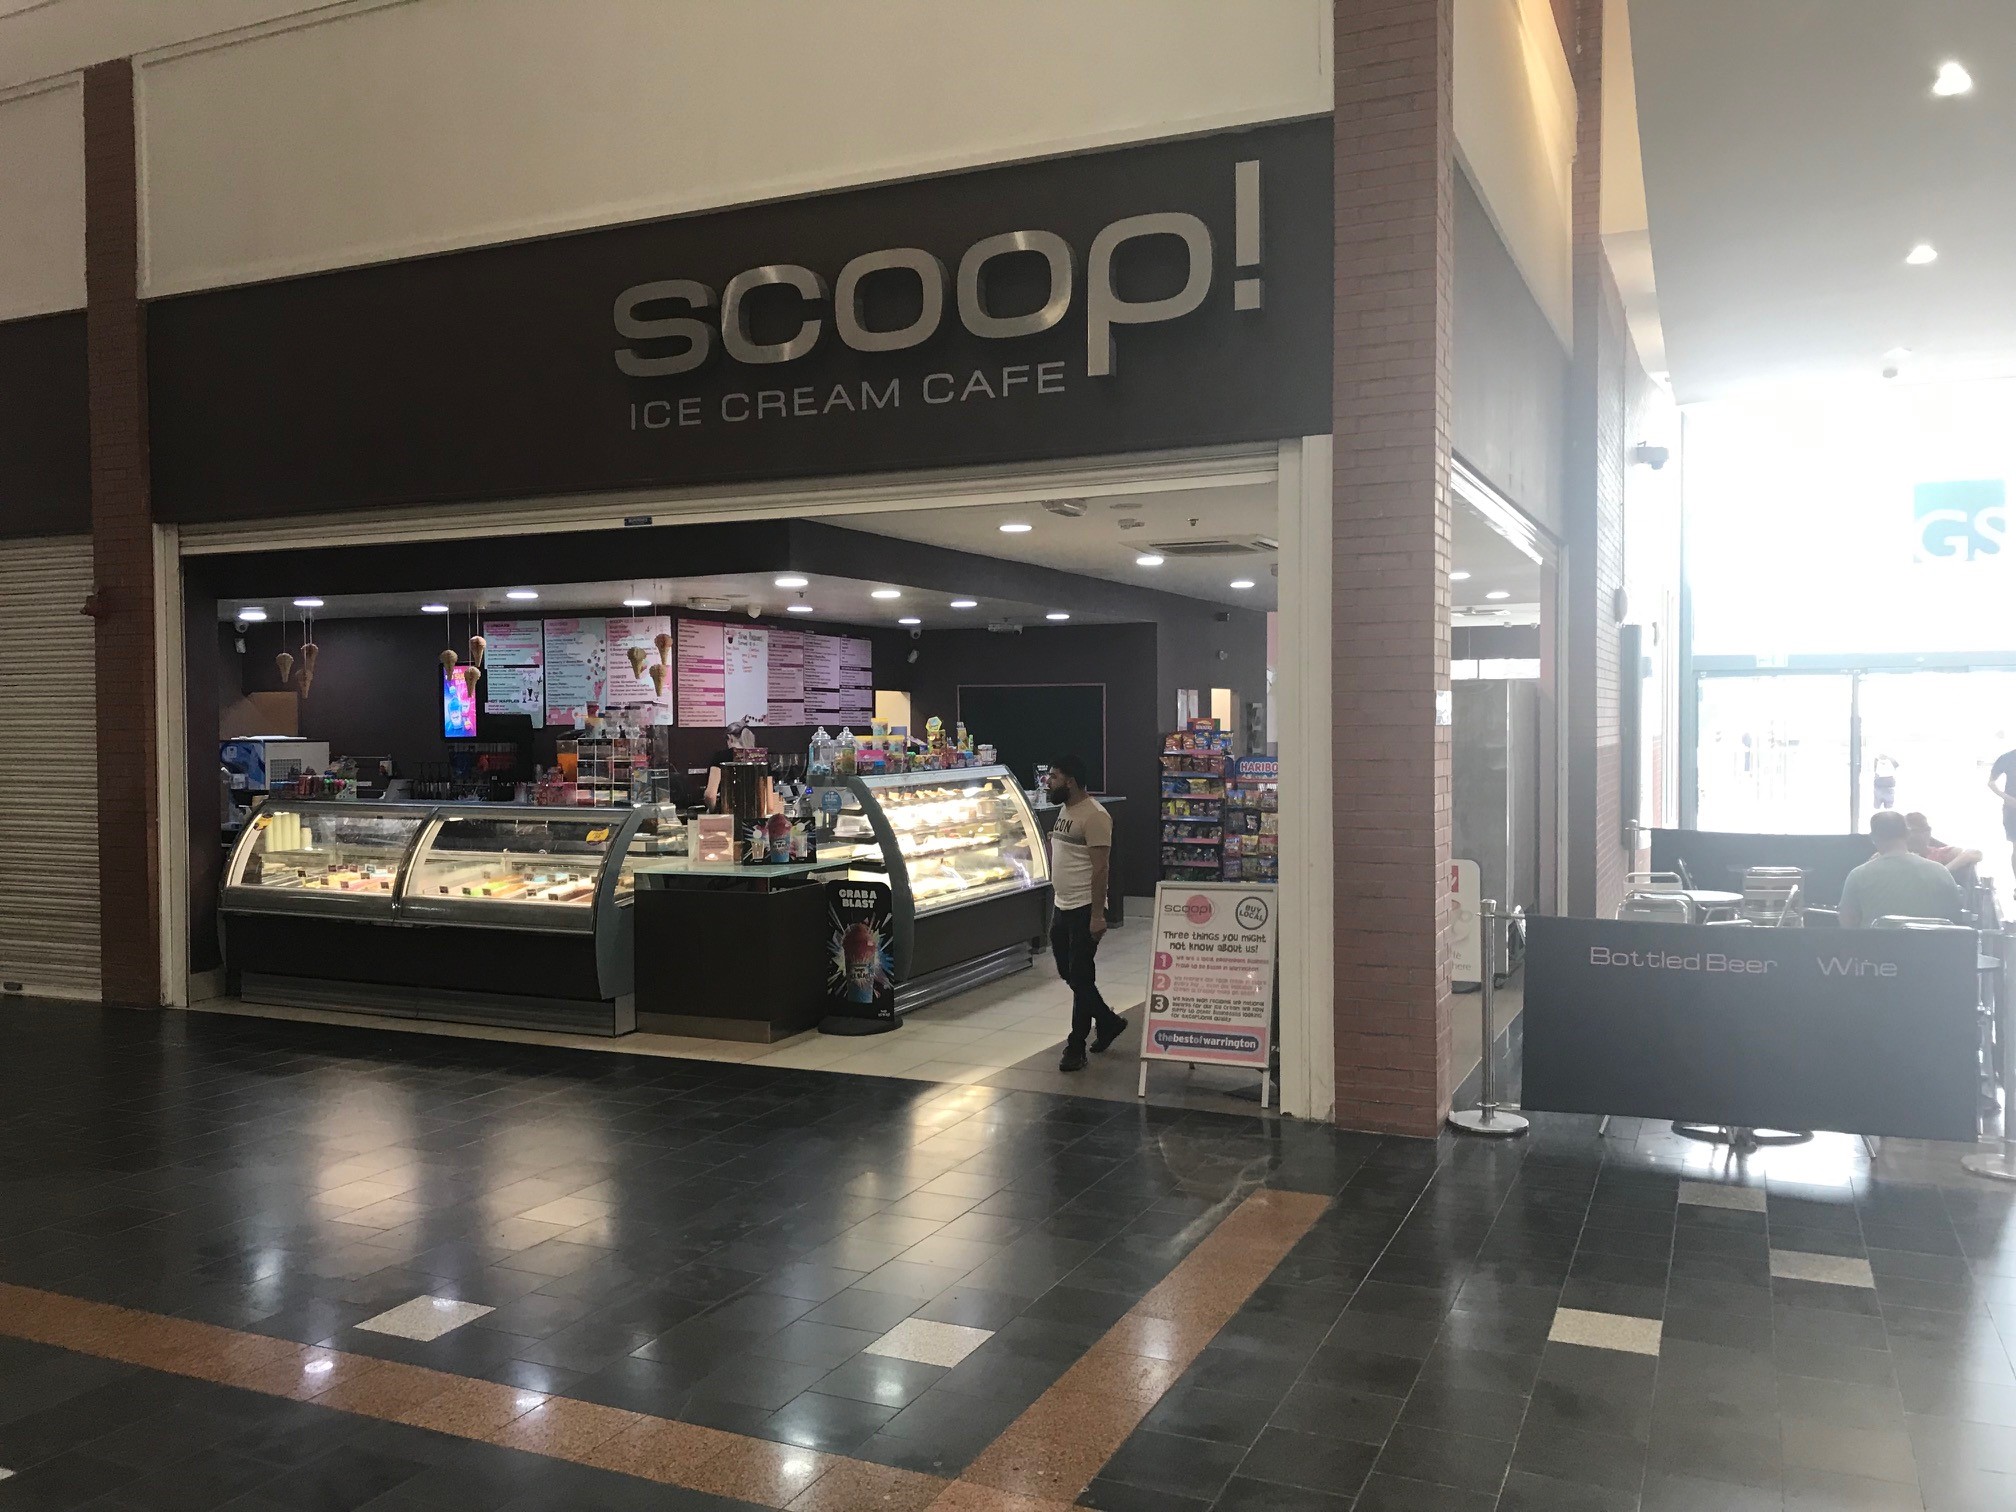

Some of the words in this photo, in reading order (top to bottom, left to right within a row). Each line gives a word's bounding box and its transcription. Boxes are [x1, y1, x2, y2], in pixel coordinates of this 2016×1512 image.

[613, 159, 1263, 378] scoop!
[629, 398, 703, 432] ICE
[720, 378, 901, 423] CREAM
[922, 360, 1067, 404] CAFE
[1239, 761, 1278, 773] HARIBO
[838, 889, 868, 899] GRAB
[842, 899, 875, 908] BLAST
[1245, 904, 1262, 913] BUY
[1239, 910, 1265, 922] LOCAL
[1163, 931, 1189, 940] Three
[1222, 933, 1238, 942] you
[1169, 942, 1186, 951] not
[1188, 942, 1214, 952] know
[1245, 944, 1258, 953] us!
[1160, 954, 1167, 967] 1
[1589, 946, 1700, 971] Bottled
[1706, 953, 1777, 973] Beer
[1816, 955, 1898, 977] Wine
[1157, 975, 1166, 988] 2
[1154, 997, 1164, 1011] 3
